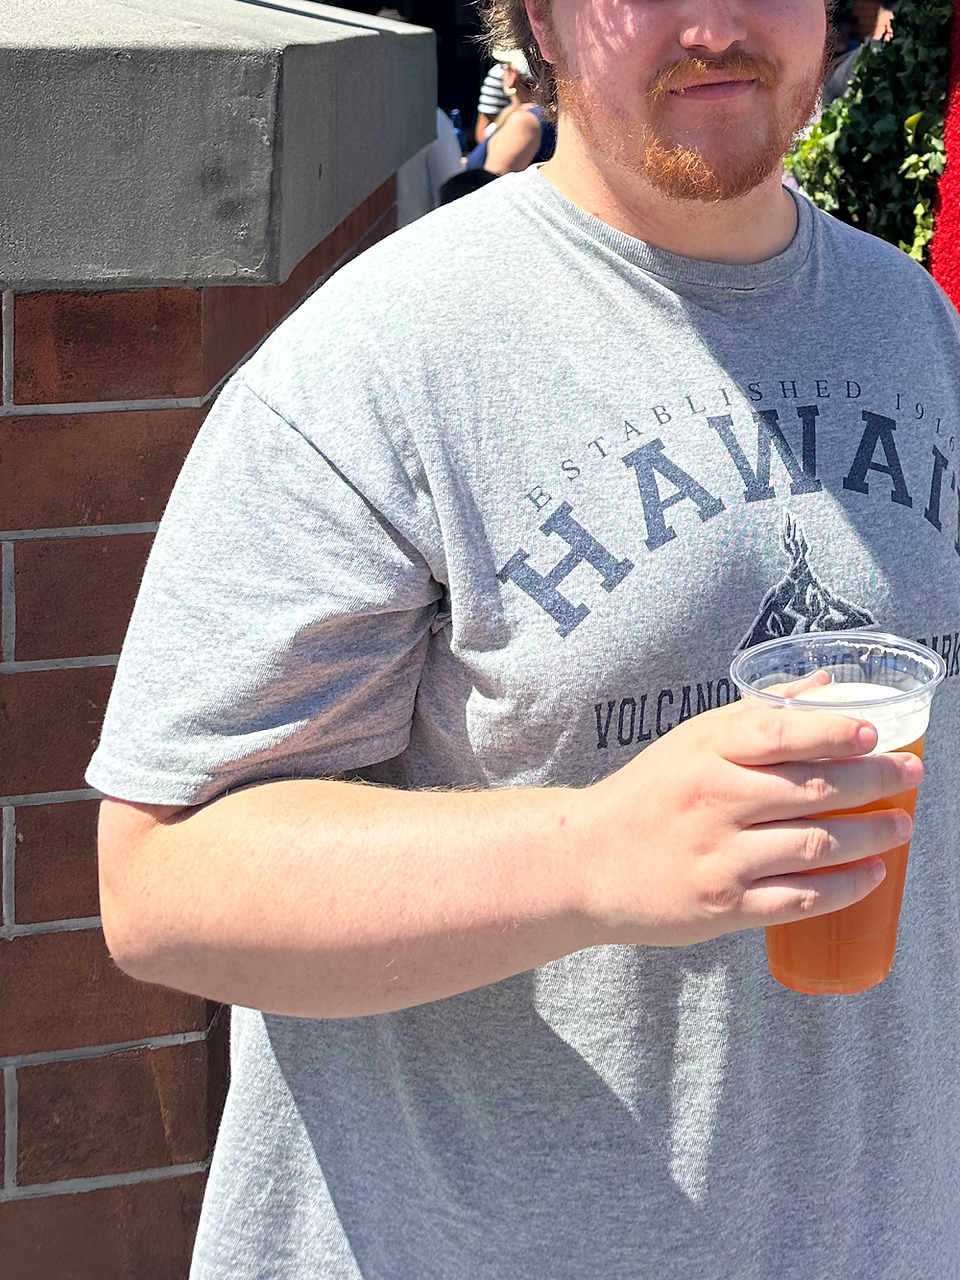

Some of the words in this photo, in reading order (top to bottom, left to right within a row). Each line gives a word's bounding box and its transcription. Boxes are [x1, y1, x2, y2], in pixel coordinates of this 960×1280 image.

[524, 379, 862, 512] ESTABLISHED
[895, 392, 956, 453] 1916
[594, 677, 742, 750] VOLCANO
